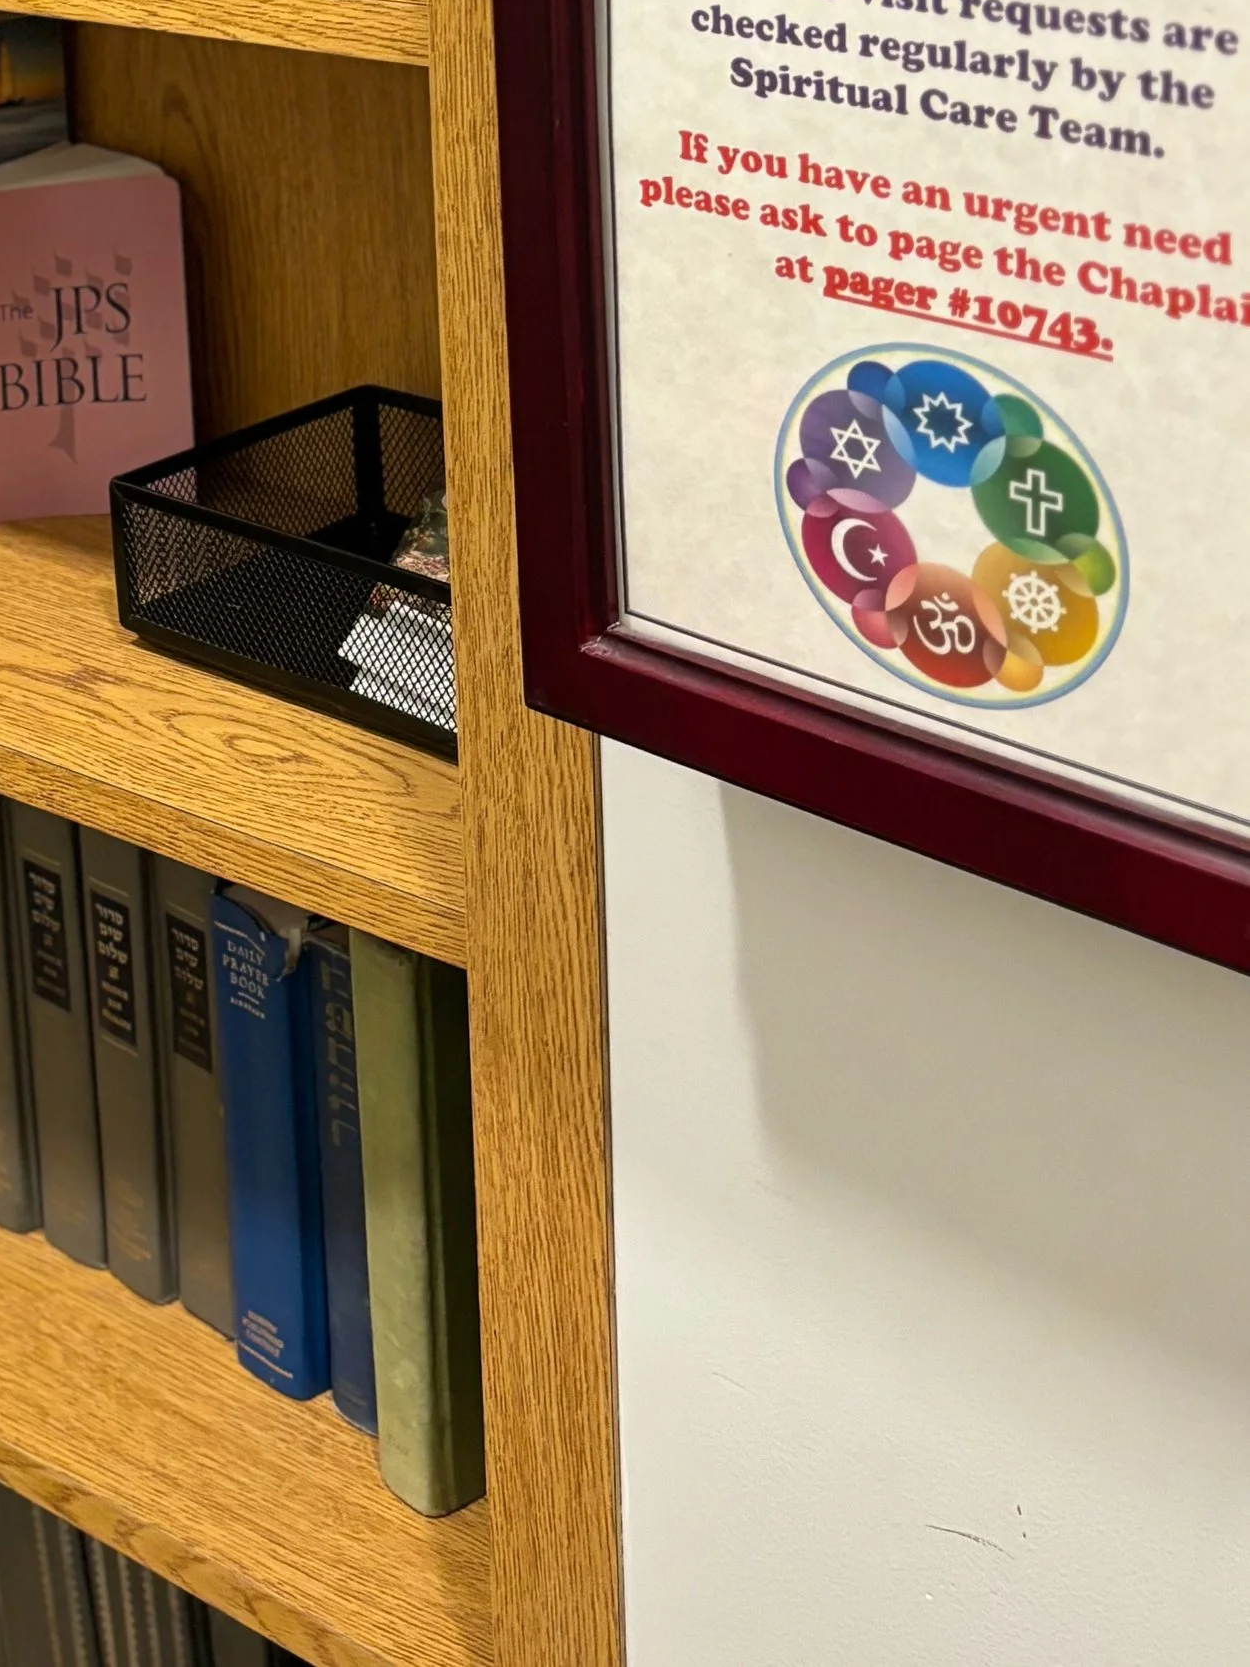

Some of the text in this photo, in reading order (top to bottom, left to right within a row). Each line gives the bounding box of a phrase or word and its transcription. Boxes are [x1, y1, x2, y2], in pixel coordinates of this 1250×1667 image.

[692, 5, 1214, 109] checked regularly by the
[1164, 23, 1238, 55] are
[731, 57, 1164, 158] Spiritual Care Team.
[640, 176, 750, 220] please
[760, 204, 827, 237] ask
[836, 215, 878, 246] to
[888, 231, 983, 273] page
[994, 247, 1065, 286] the
[679, 130, 1231, 265] If you have an urgent need
[50, 282, 132, 352] JPS
[775, 256, 1115, 352] at pager #10743.
[221, 952, 270, 987] PRAYER
[226, 939, 266, 967] DAILY
[229, 970, 267, 1001] BOOK
